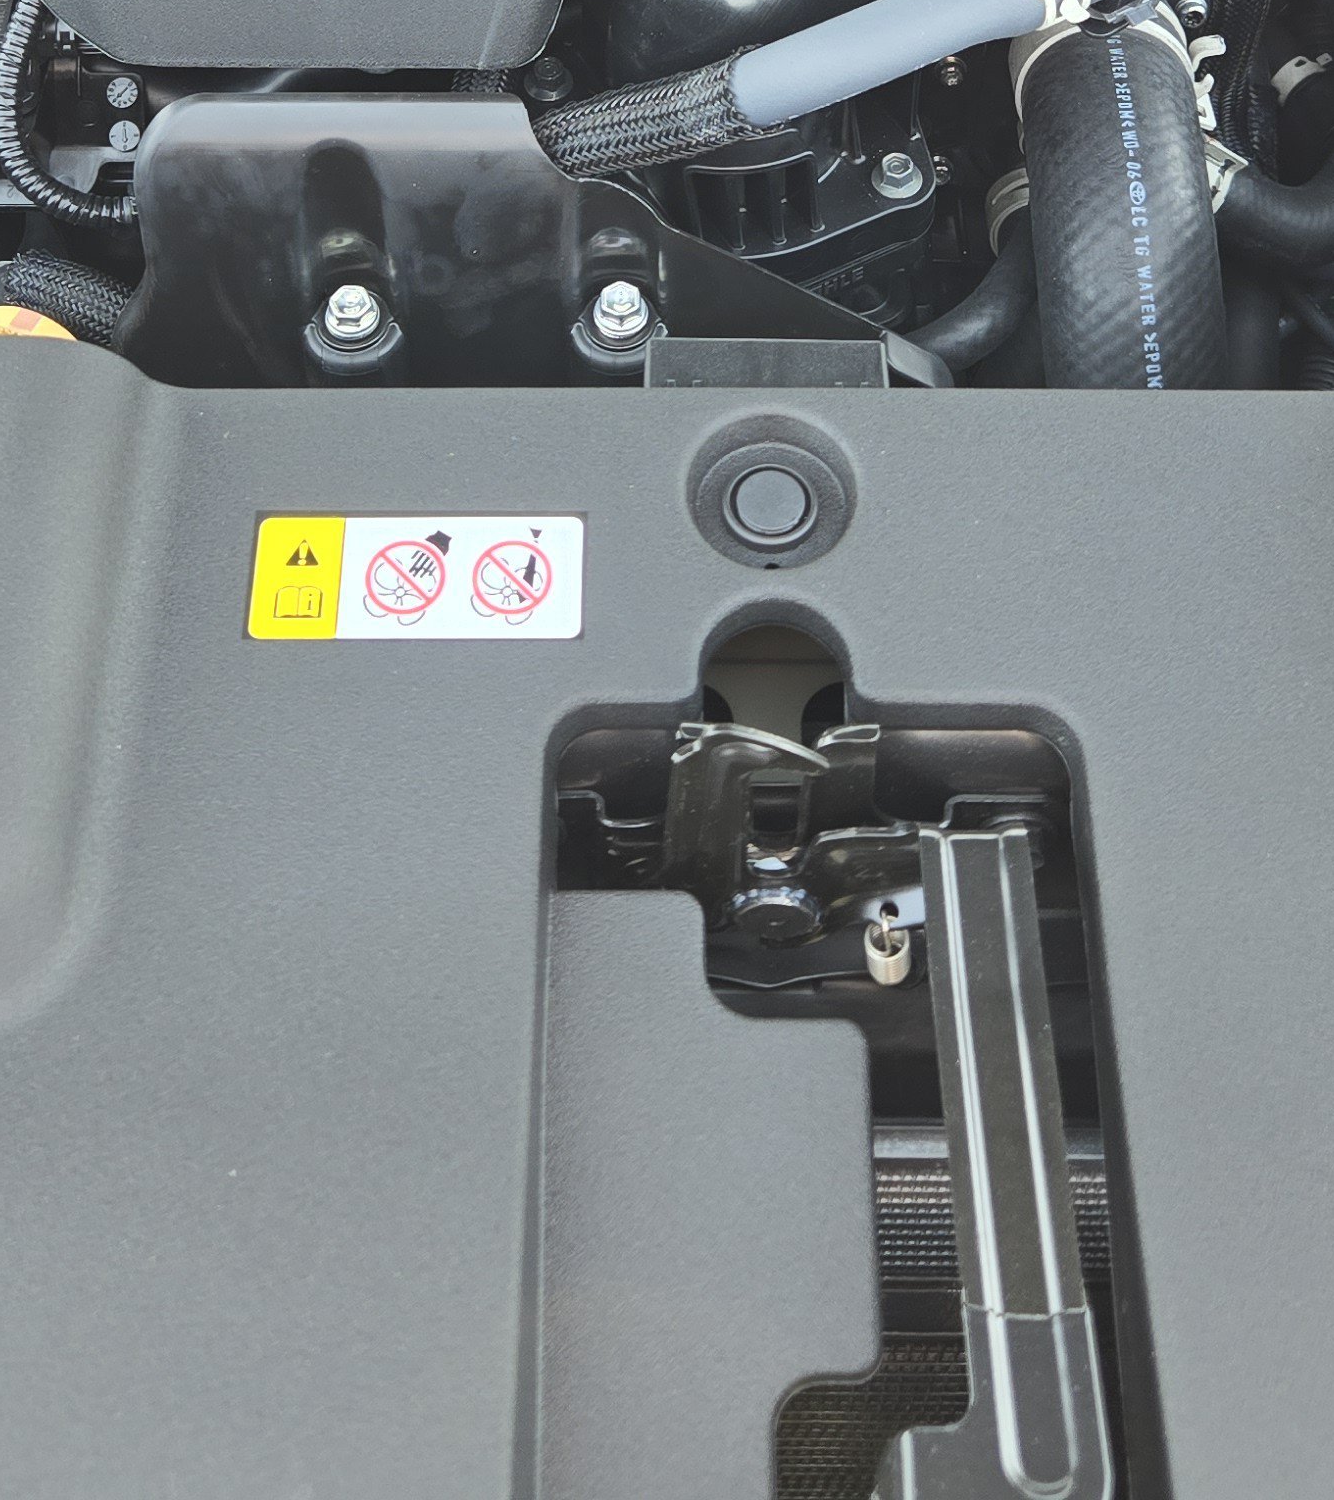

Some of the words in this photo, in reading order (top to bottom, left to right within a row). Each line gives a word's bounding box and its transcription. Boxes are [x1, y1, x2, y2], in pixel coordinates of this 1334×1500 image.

[1109, 47, 1129, 79] WATER
[1130, 206, 1150, 228] LC
[1133, 235, 1151, 257] TG
[1137, 265, 1157, 326] WATER
